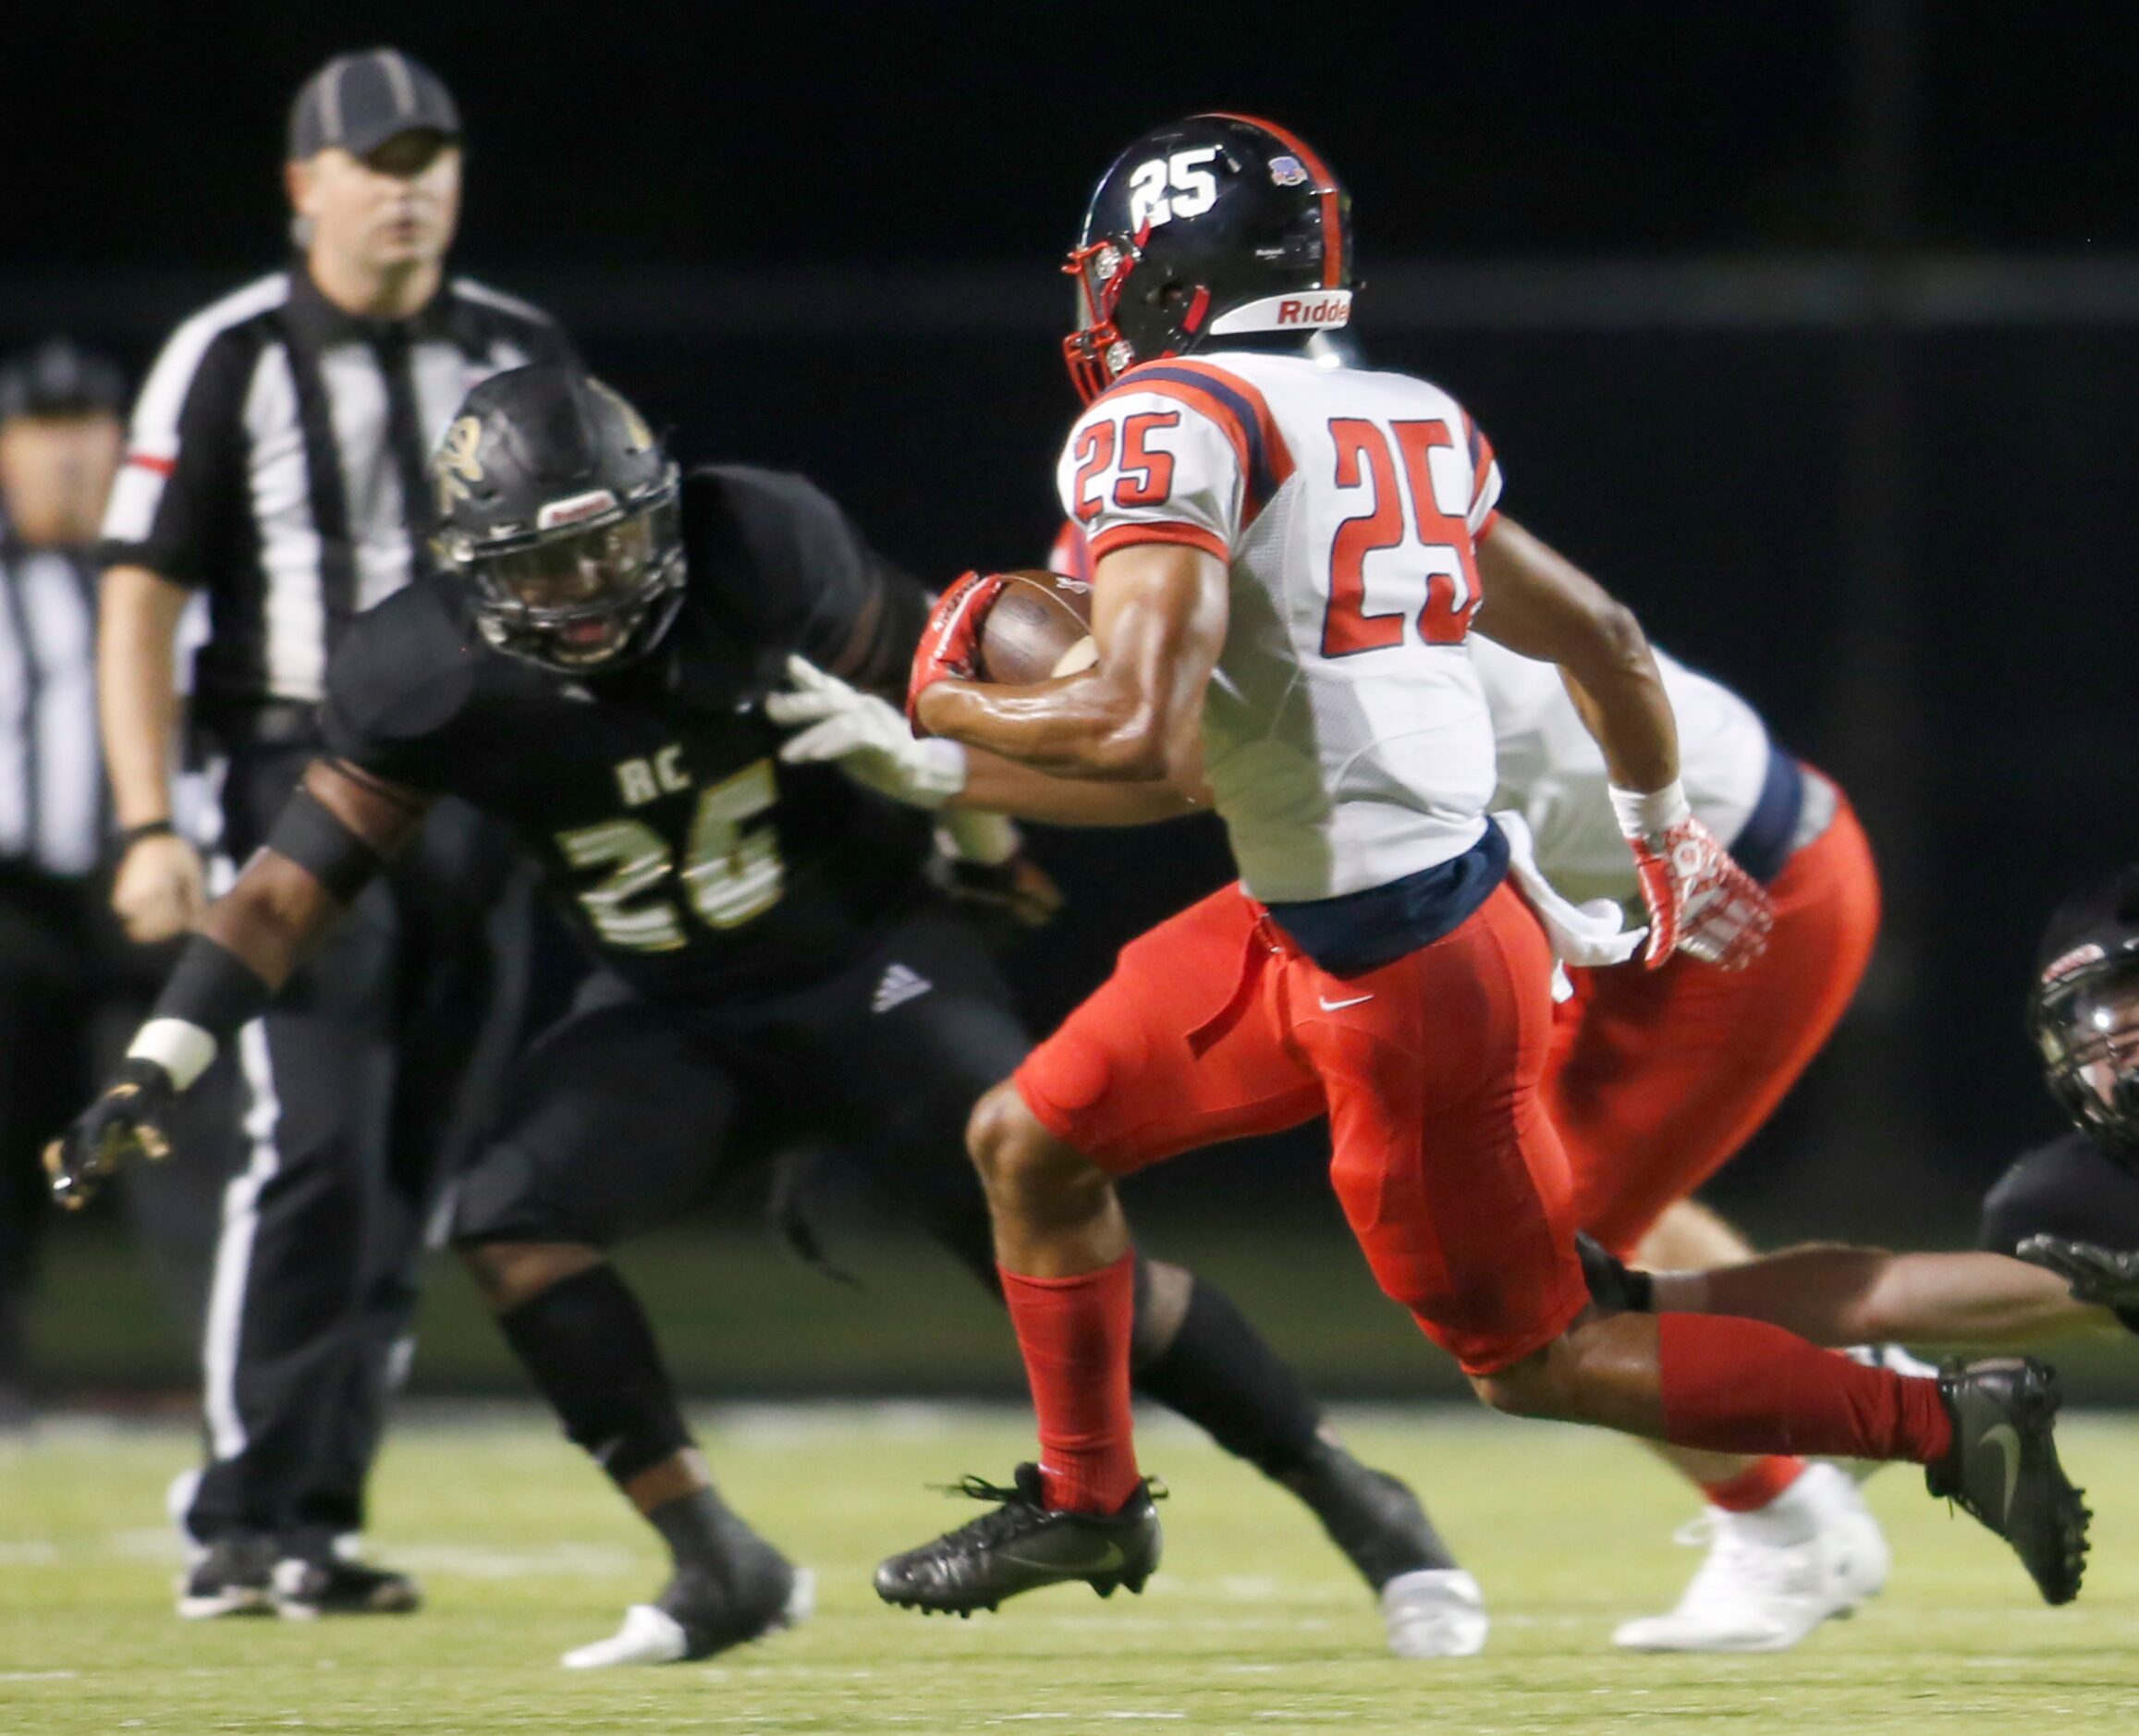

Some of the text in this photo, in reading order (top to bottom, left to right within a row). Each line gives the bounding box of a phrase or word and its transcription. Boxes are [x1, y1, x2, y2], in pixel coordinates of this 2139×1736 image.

[1130, 148, 1216, 234] 25
[1073, 410, 1180, 524] 25
[1320, 417, 1482, 658] 25
[614, 742, 691, 808] RC
[556, 756, 784, 951] 26
